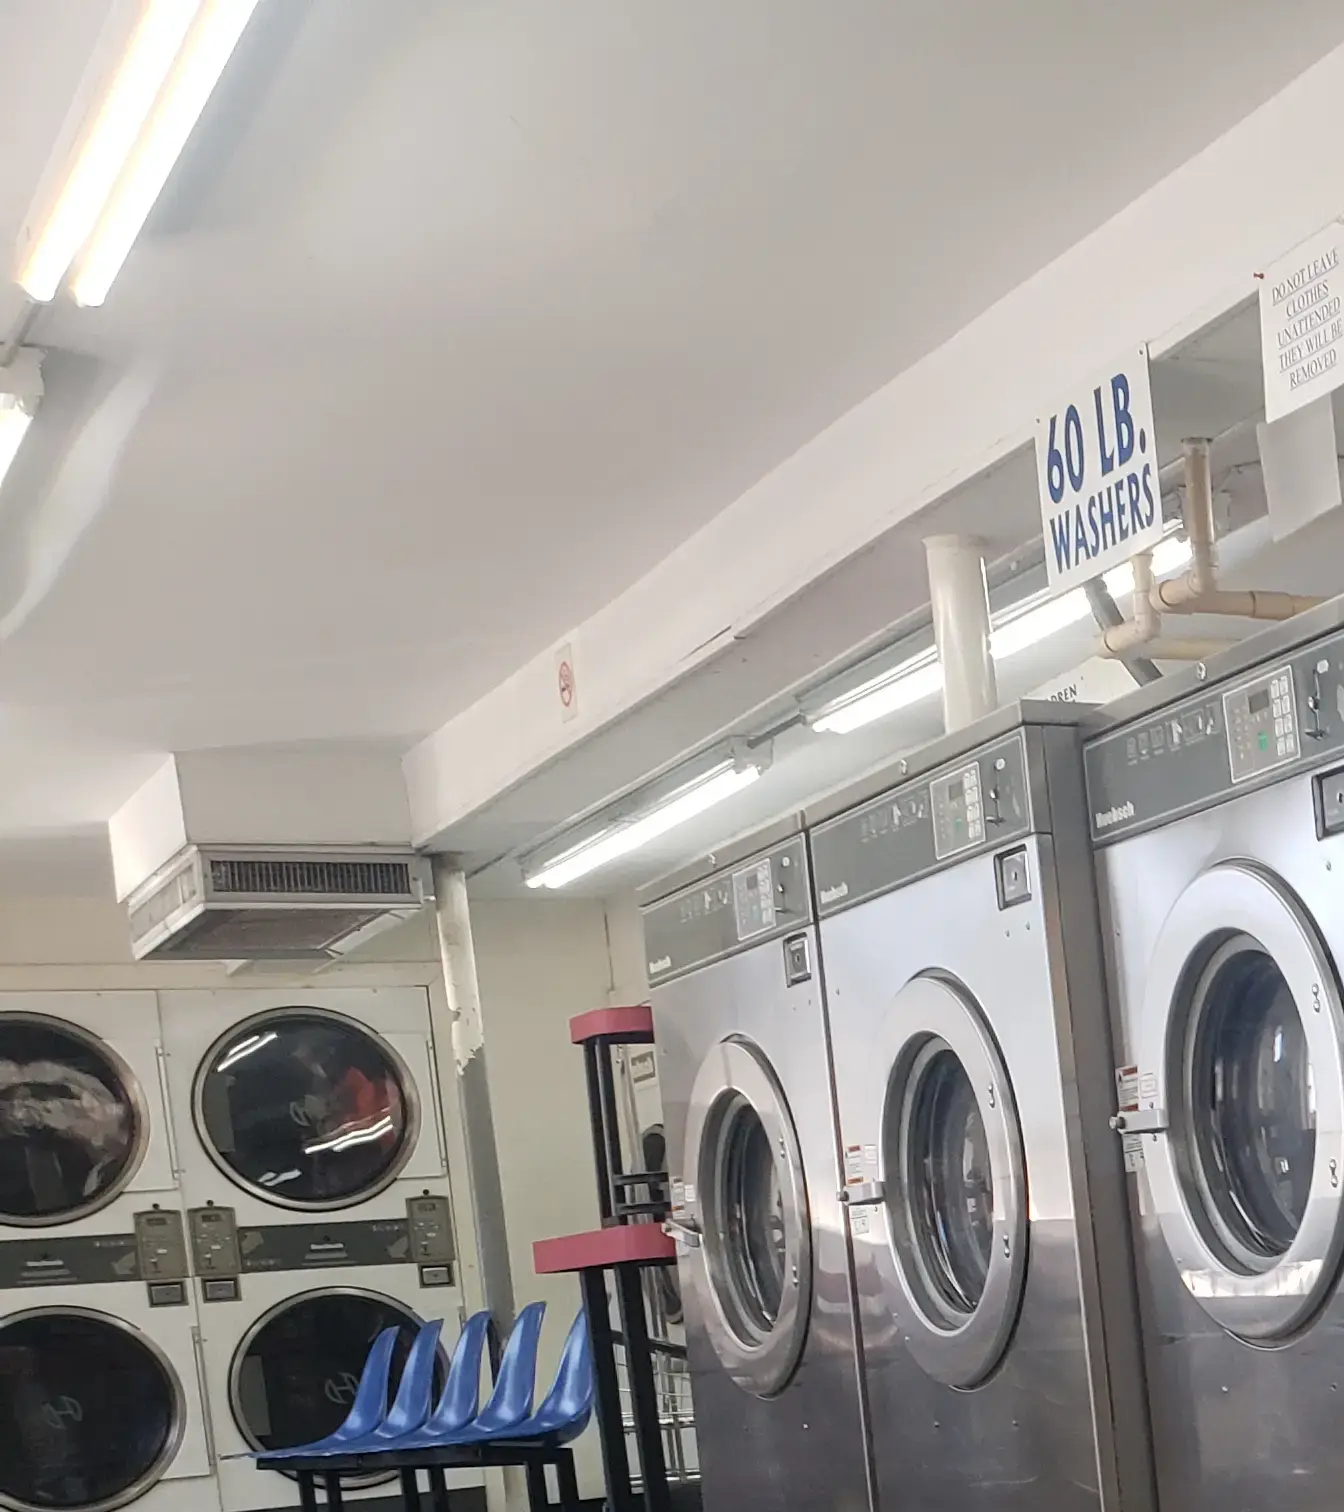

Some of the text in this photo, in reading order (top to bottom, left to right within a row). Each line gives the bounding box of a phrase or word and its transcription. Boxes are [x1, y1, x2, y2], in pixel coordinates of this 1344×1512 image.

[1272, 247, 1339, 302] DO NOT LEAVE
[1285, 279, 1329, 318] CLOTHES
[1277, 296, 1341, 347] UNATTENDED
[1279, 318, 1343, 370] THEY WILL BE
[1289, 348, 1337, 389] REMOVED
[1047, 373, 1146, 504] 60 LB.
[1049, 463, 1154, 574] WASHERS
